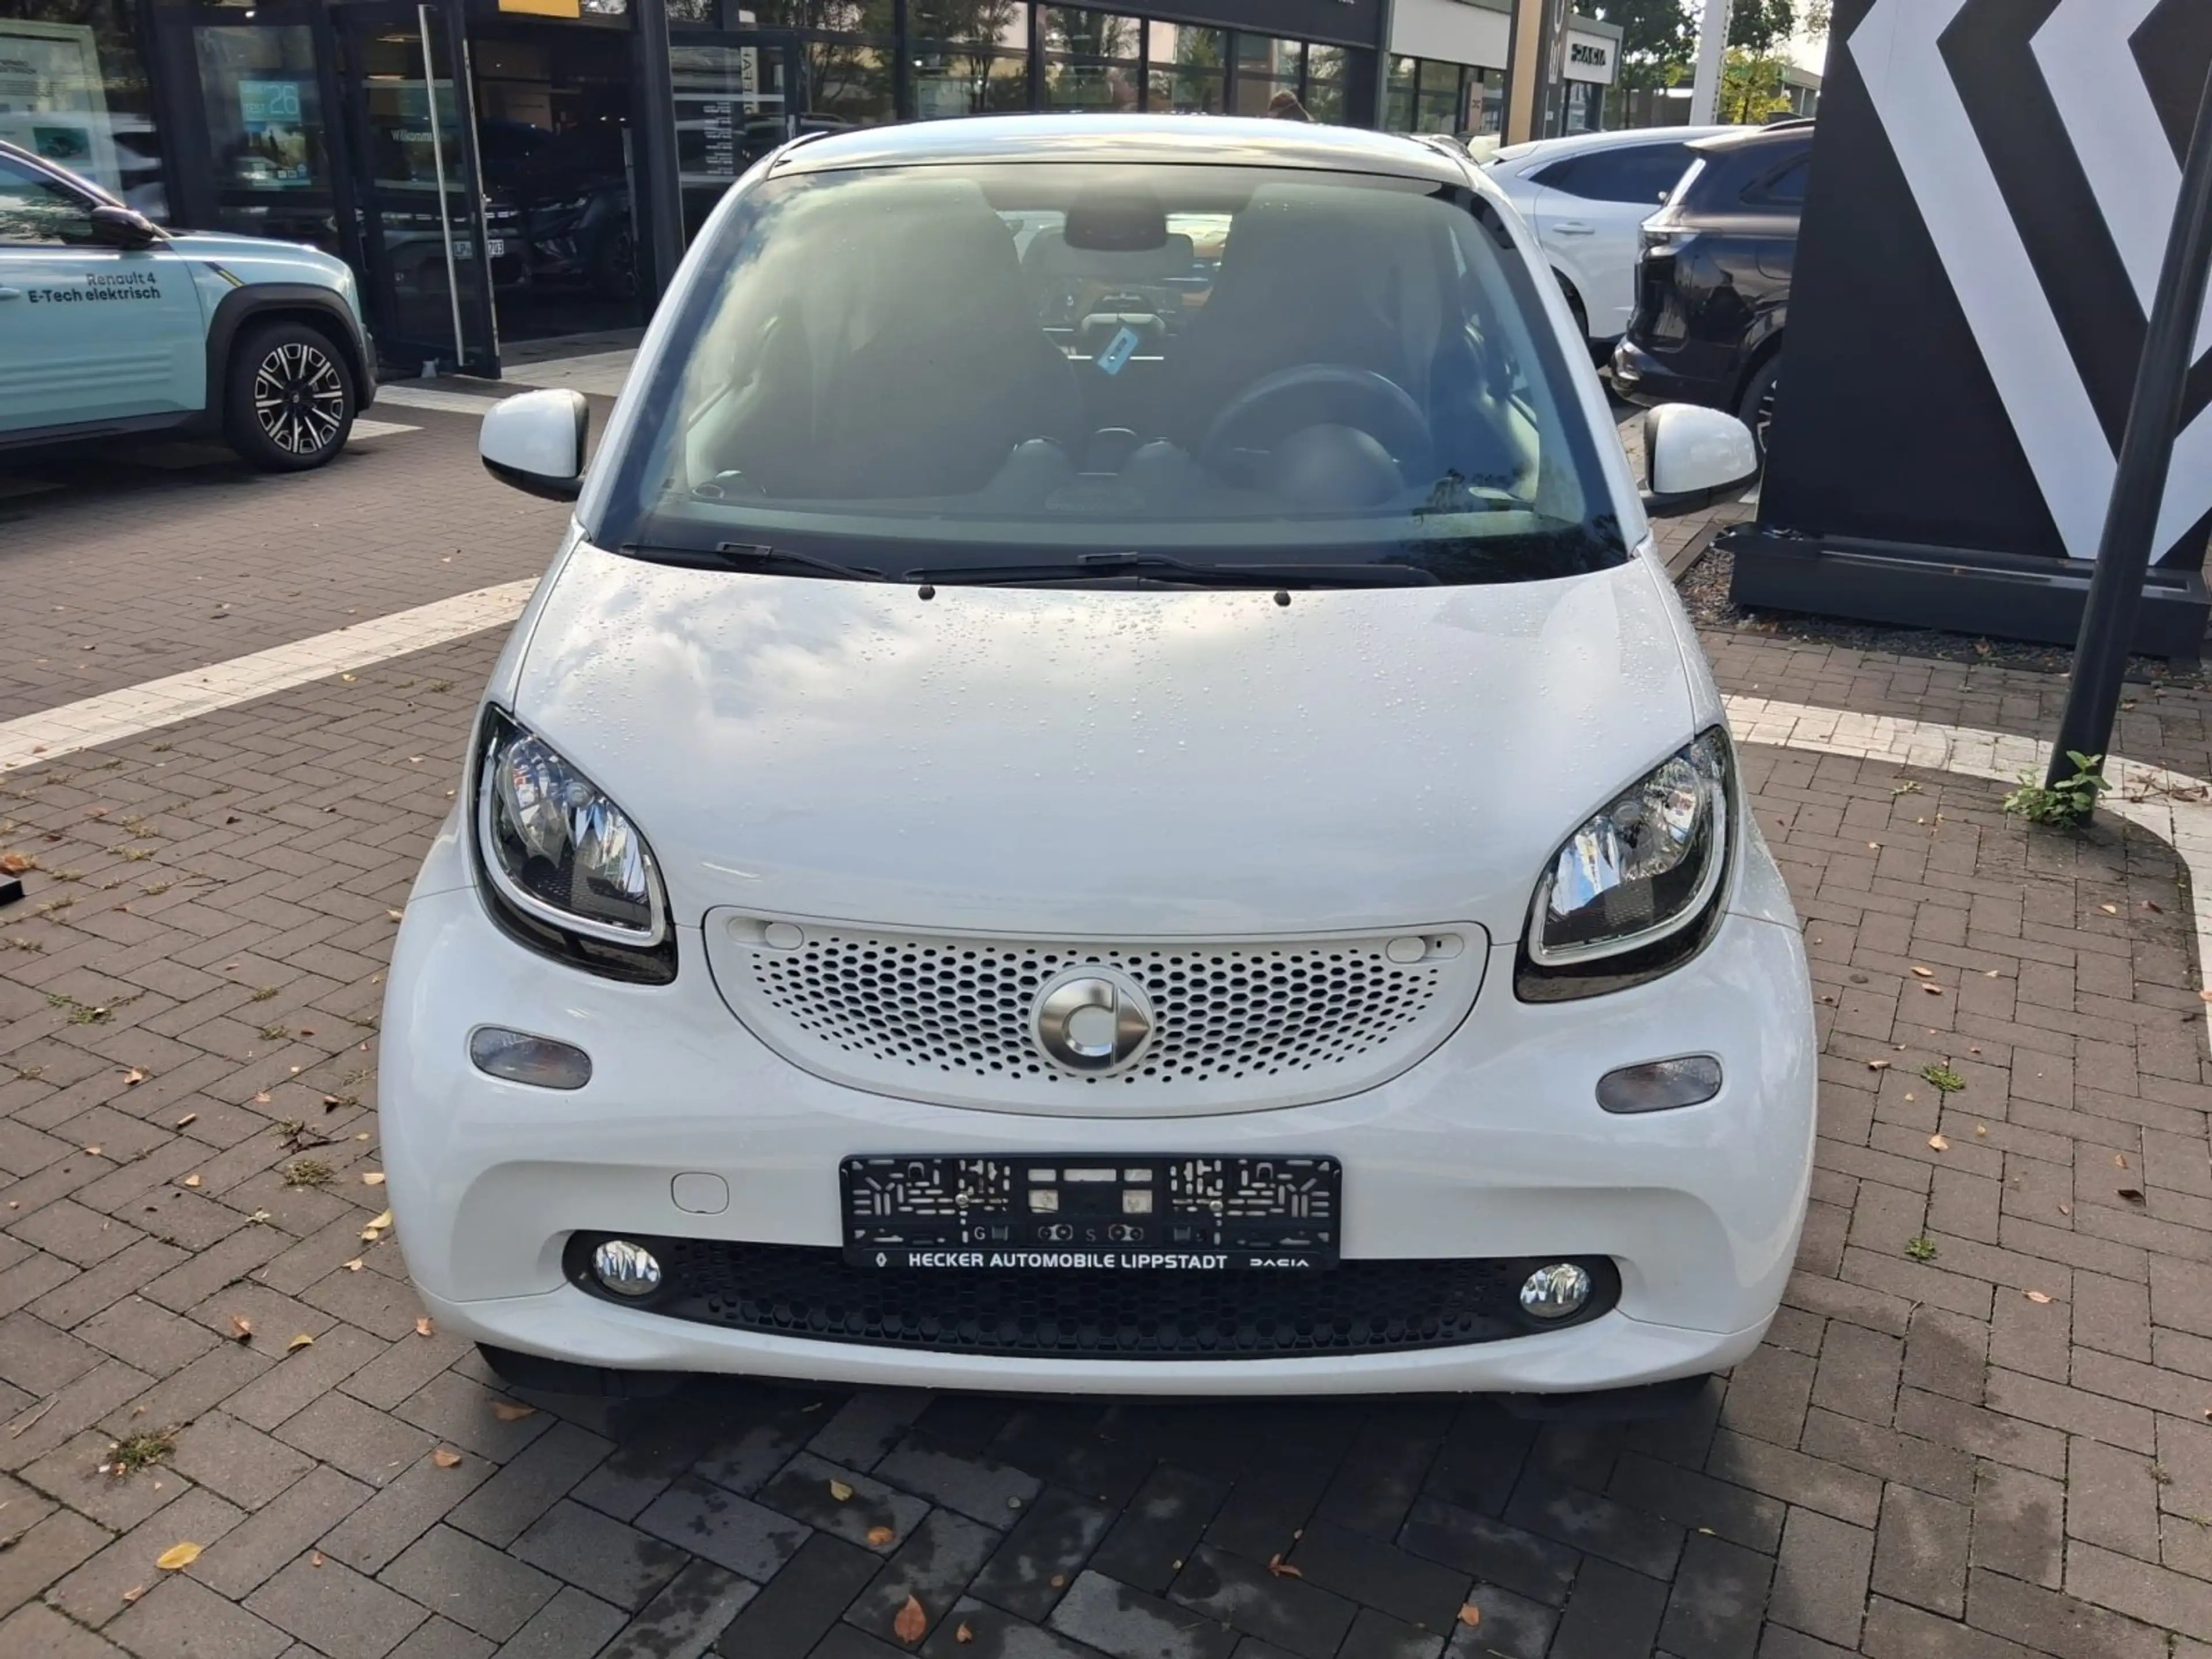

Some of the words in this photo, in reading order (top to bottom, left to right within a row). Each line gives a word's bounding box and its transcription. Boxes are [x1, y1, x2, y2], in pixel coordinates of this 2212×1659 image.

[86, 272, 145, 286] Renault
[147, 272, 156, 283] 4
[28, 288, 83, 303] E-Tech
[86, 286, 161, 301] elektrisch
[908, 1252, 984, 1267] HECKER
[989, 1253, 1115, 1268] AUTOMOBILE
[1121, 1254, 1228, 1269] LIPPSTADT
[1249, 1257, 1310, 1267] DACIA
